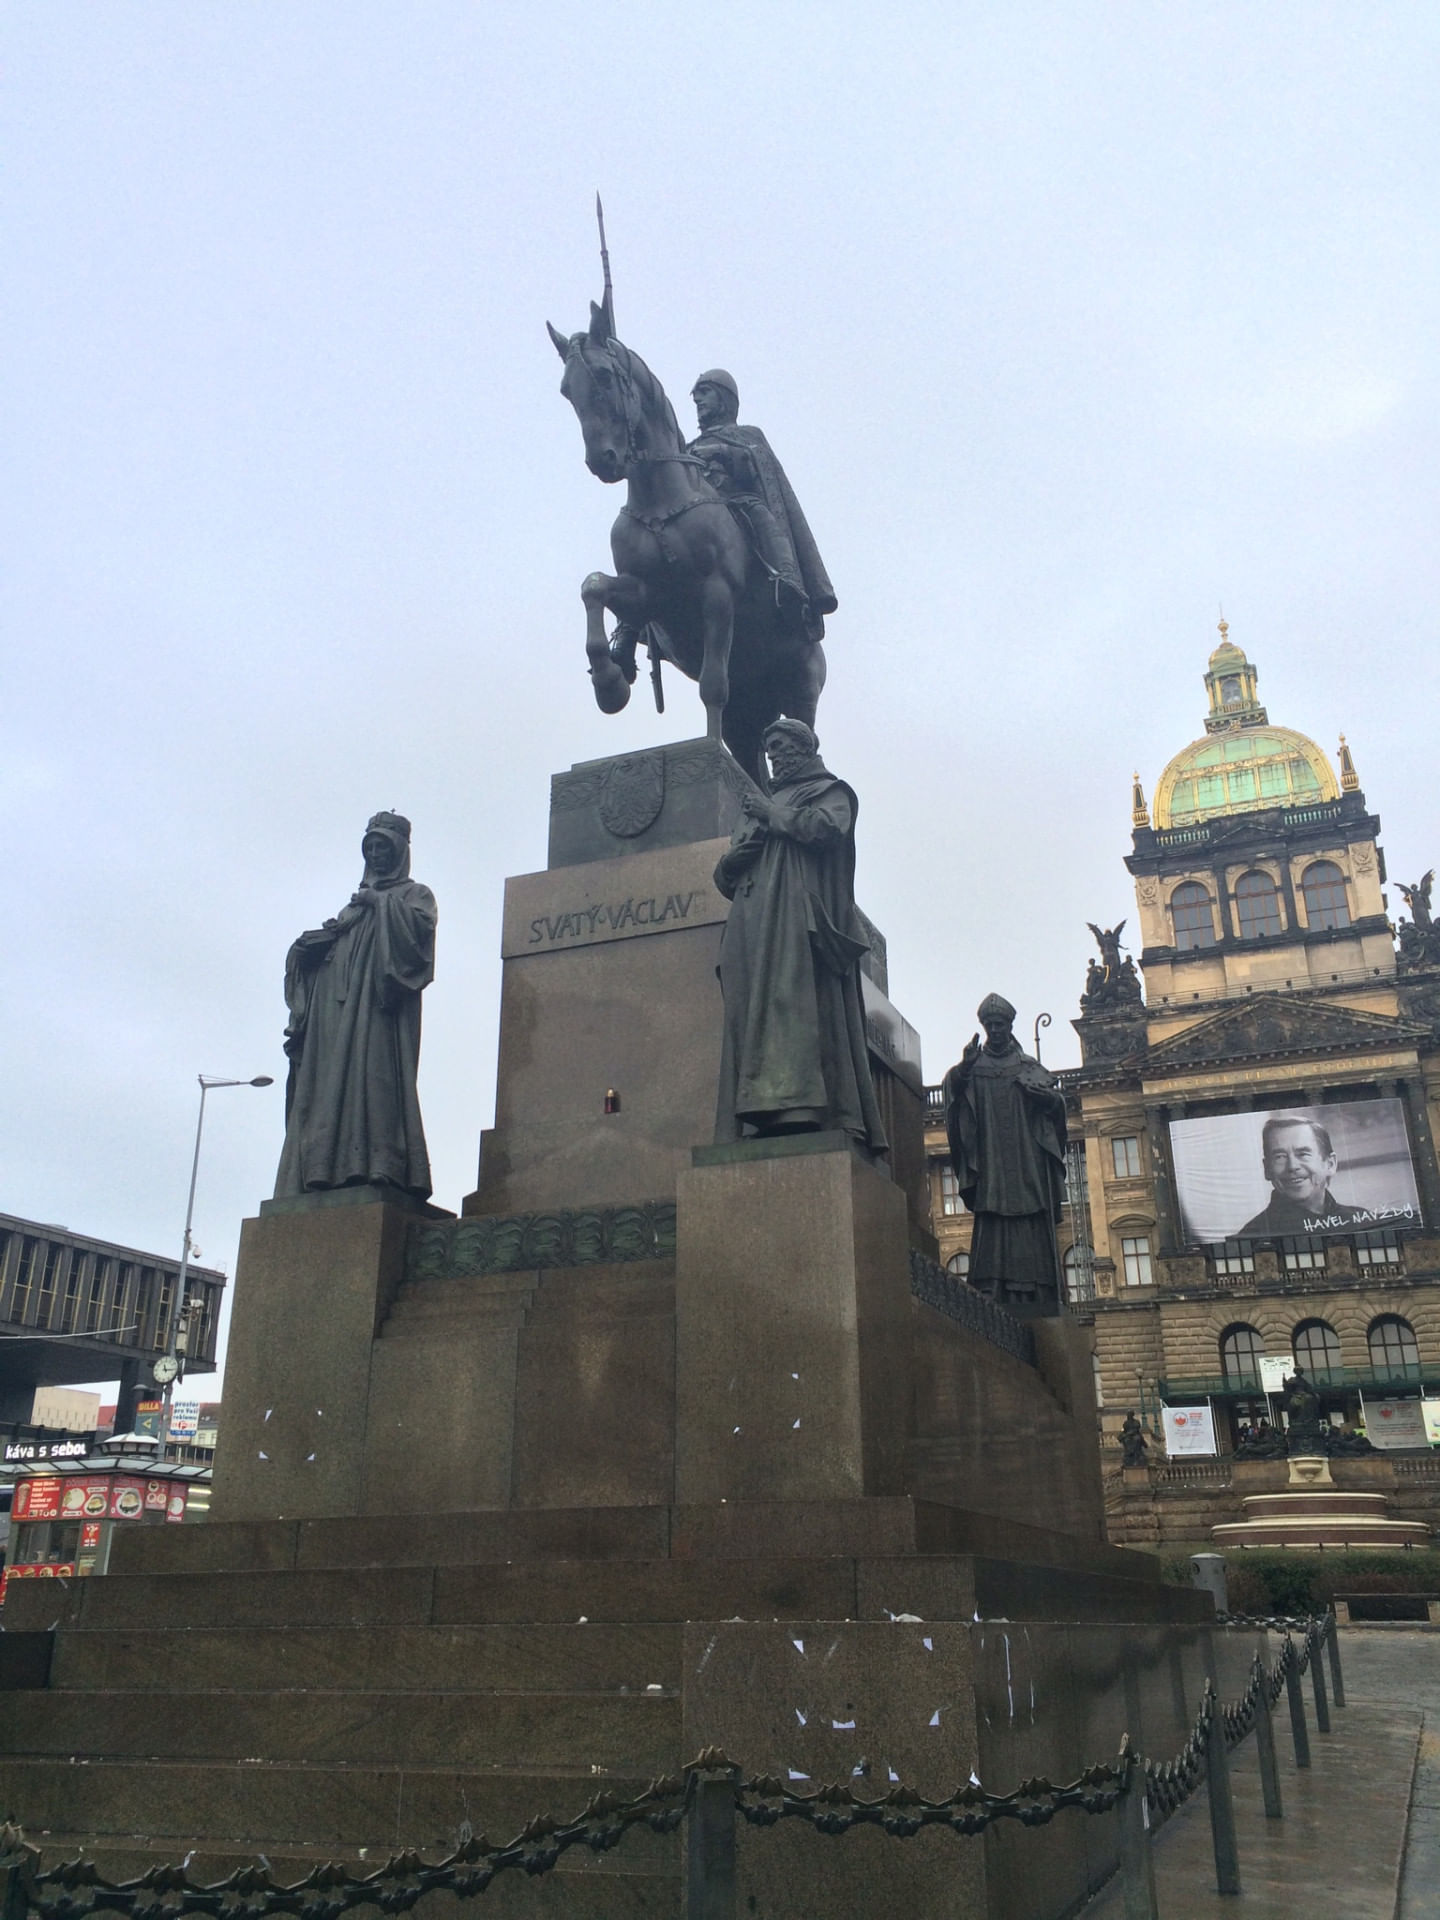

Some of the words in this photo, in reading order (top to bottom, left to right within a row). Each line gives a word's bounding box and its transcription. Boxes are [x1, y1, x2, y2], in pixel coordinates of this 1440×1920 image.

[1303, 1215, 1349, 1232] HAVEL
[5, 1444, 34, 1459] káva
[39, 1445, 47, 1457] s
